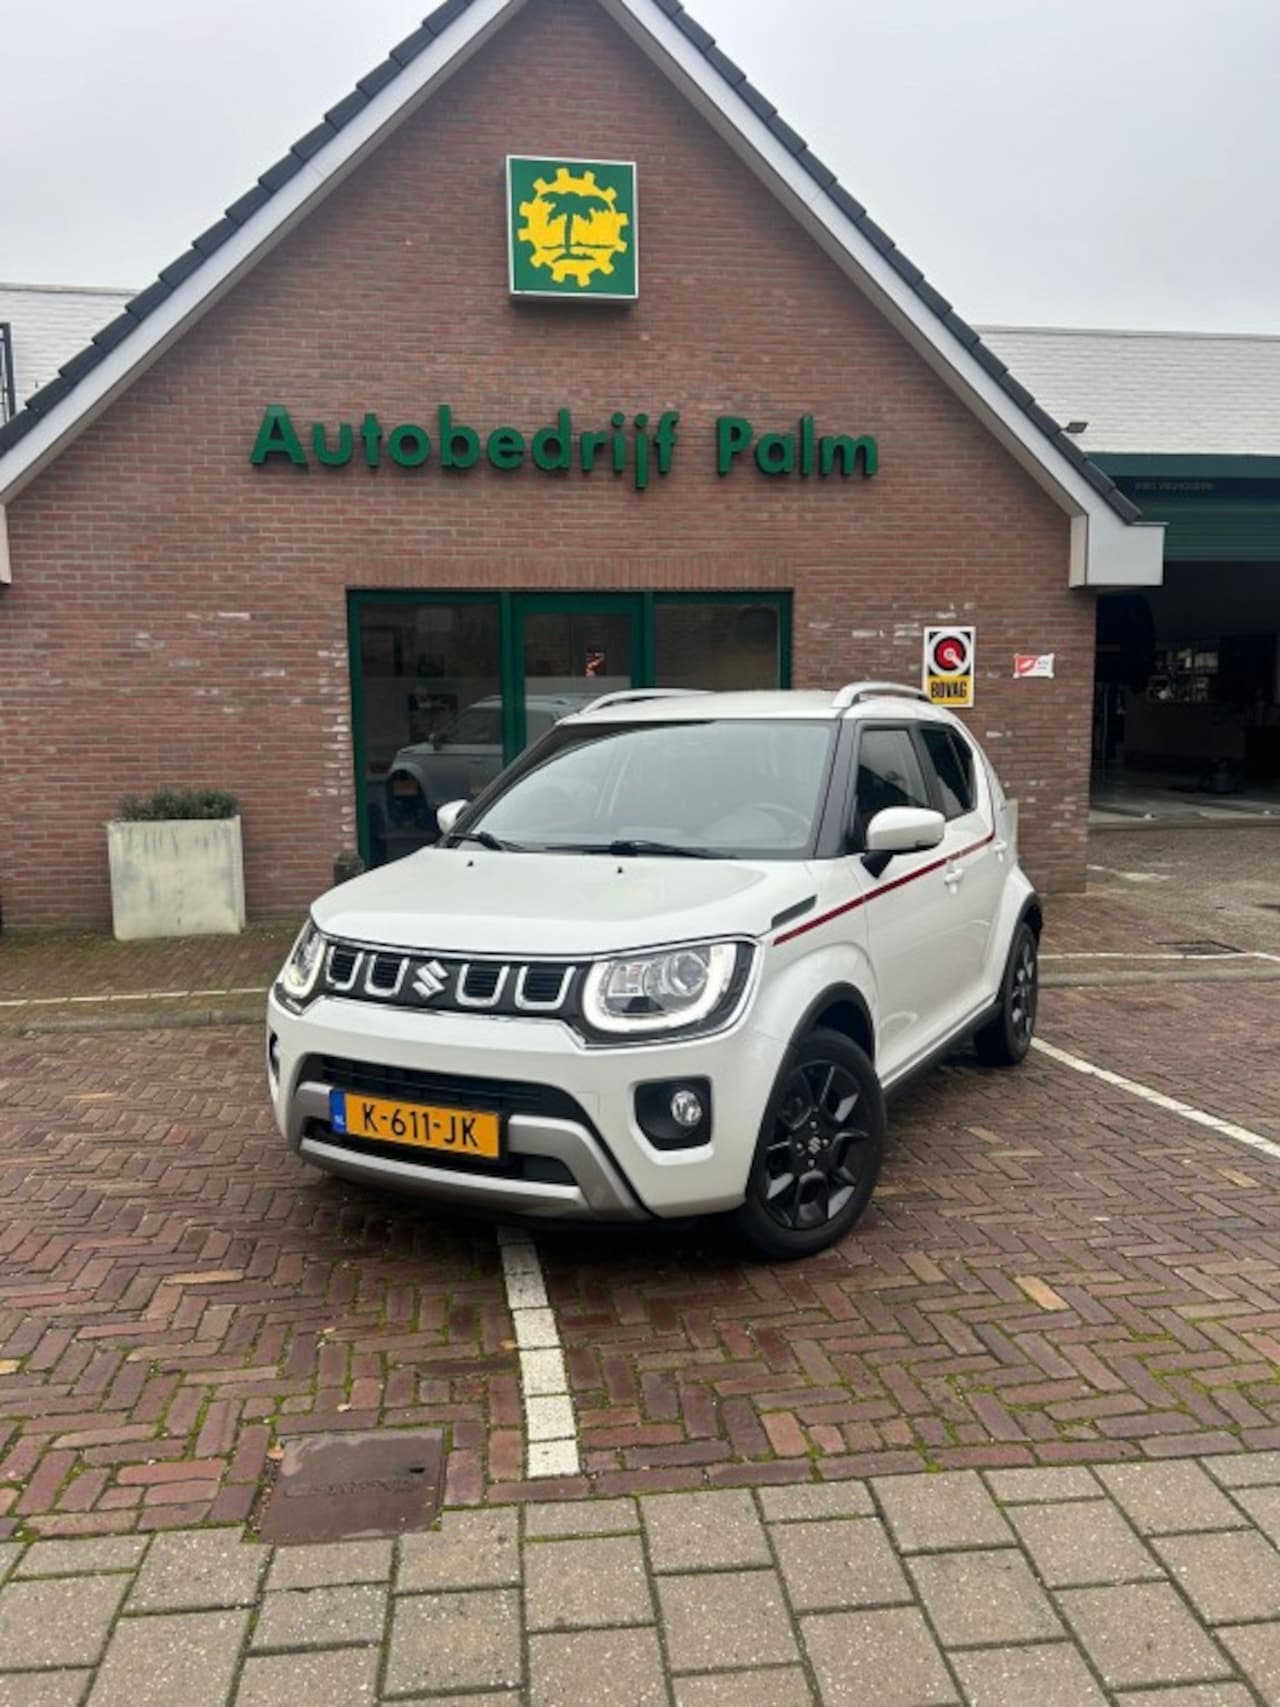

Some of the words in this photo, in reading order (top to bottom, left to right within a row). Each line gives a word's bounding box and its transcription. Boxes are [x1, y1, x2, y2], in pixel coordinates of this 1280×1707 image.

[250, 404, 680, 489] Autobedrijf
[716, 413, 879, 477] Palm
[930, 681, 967, 698] BOVAG
[362, 1102, 478, 1147] K-611-JK
